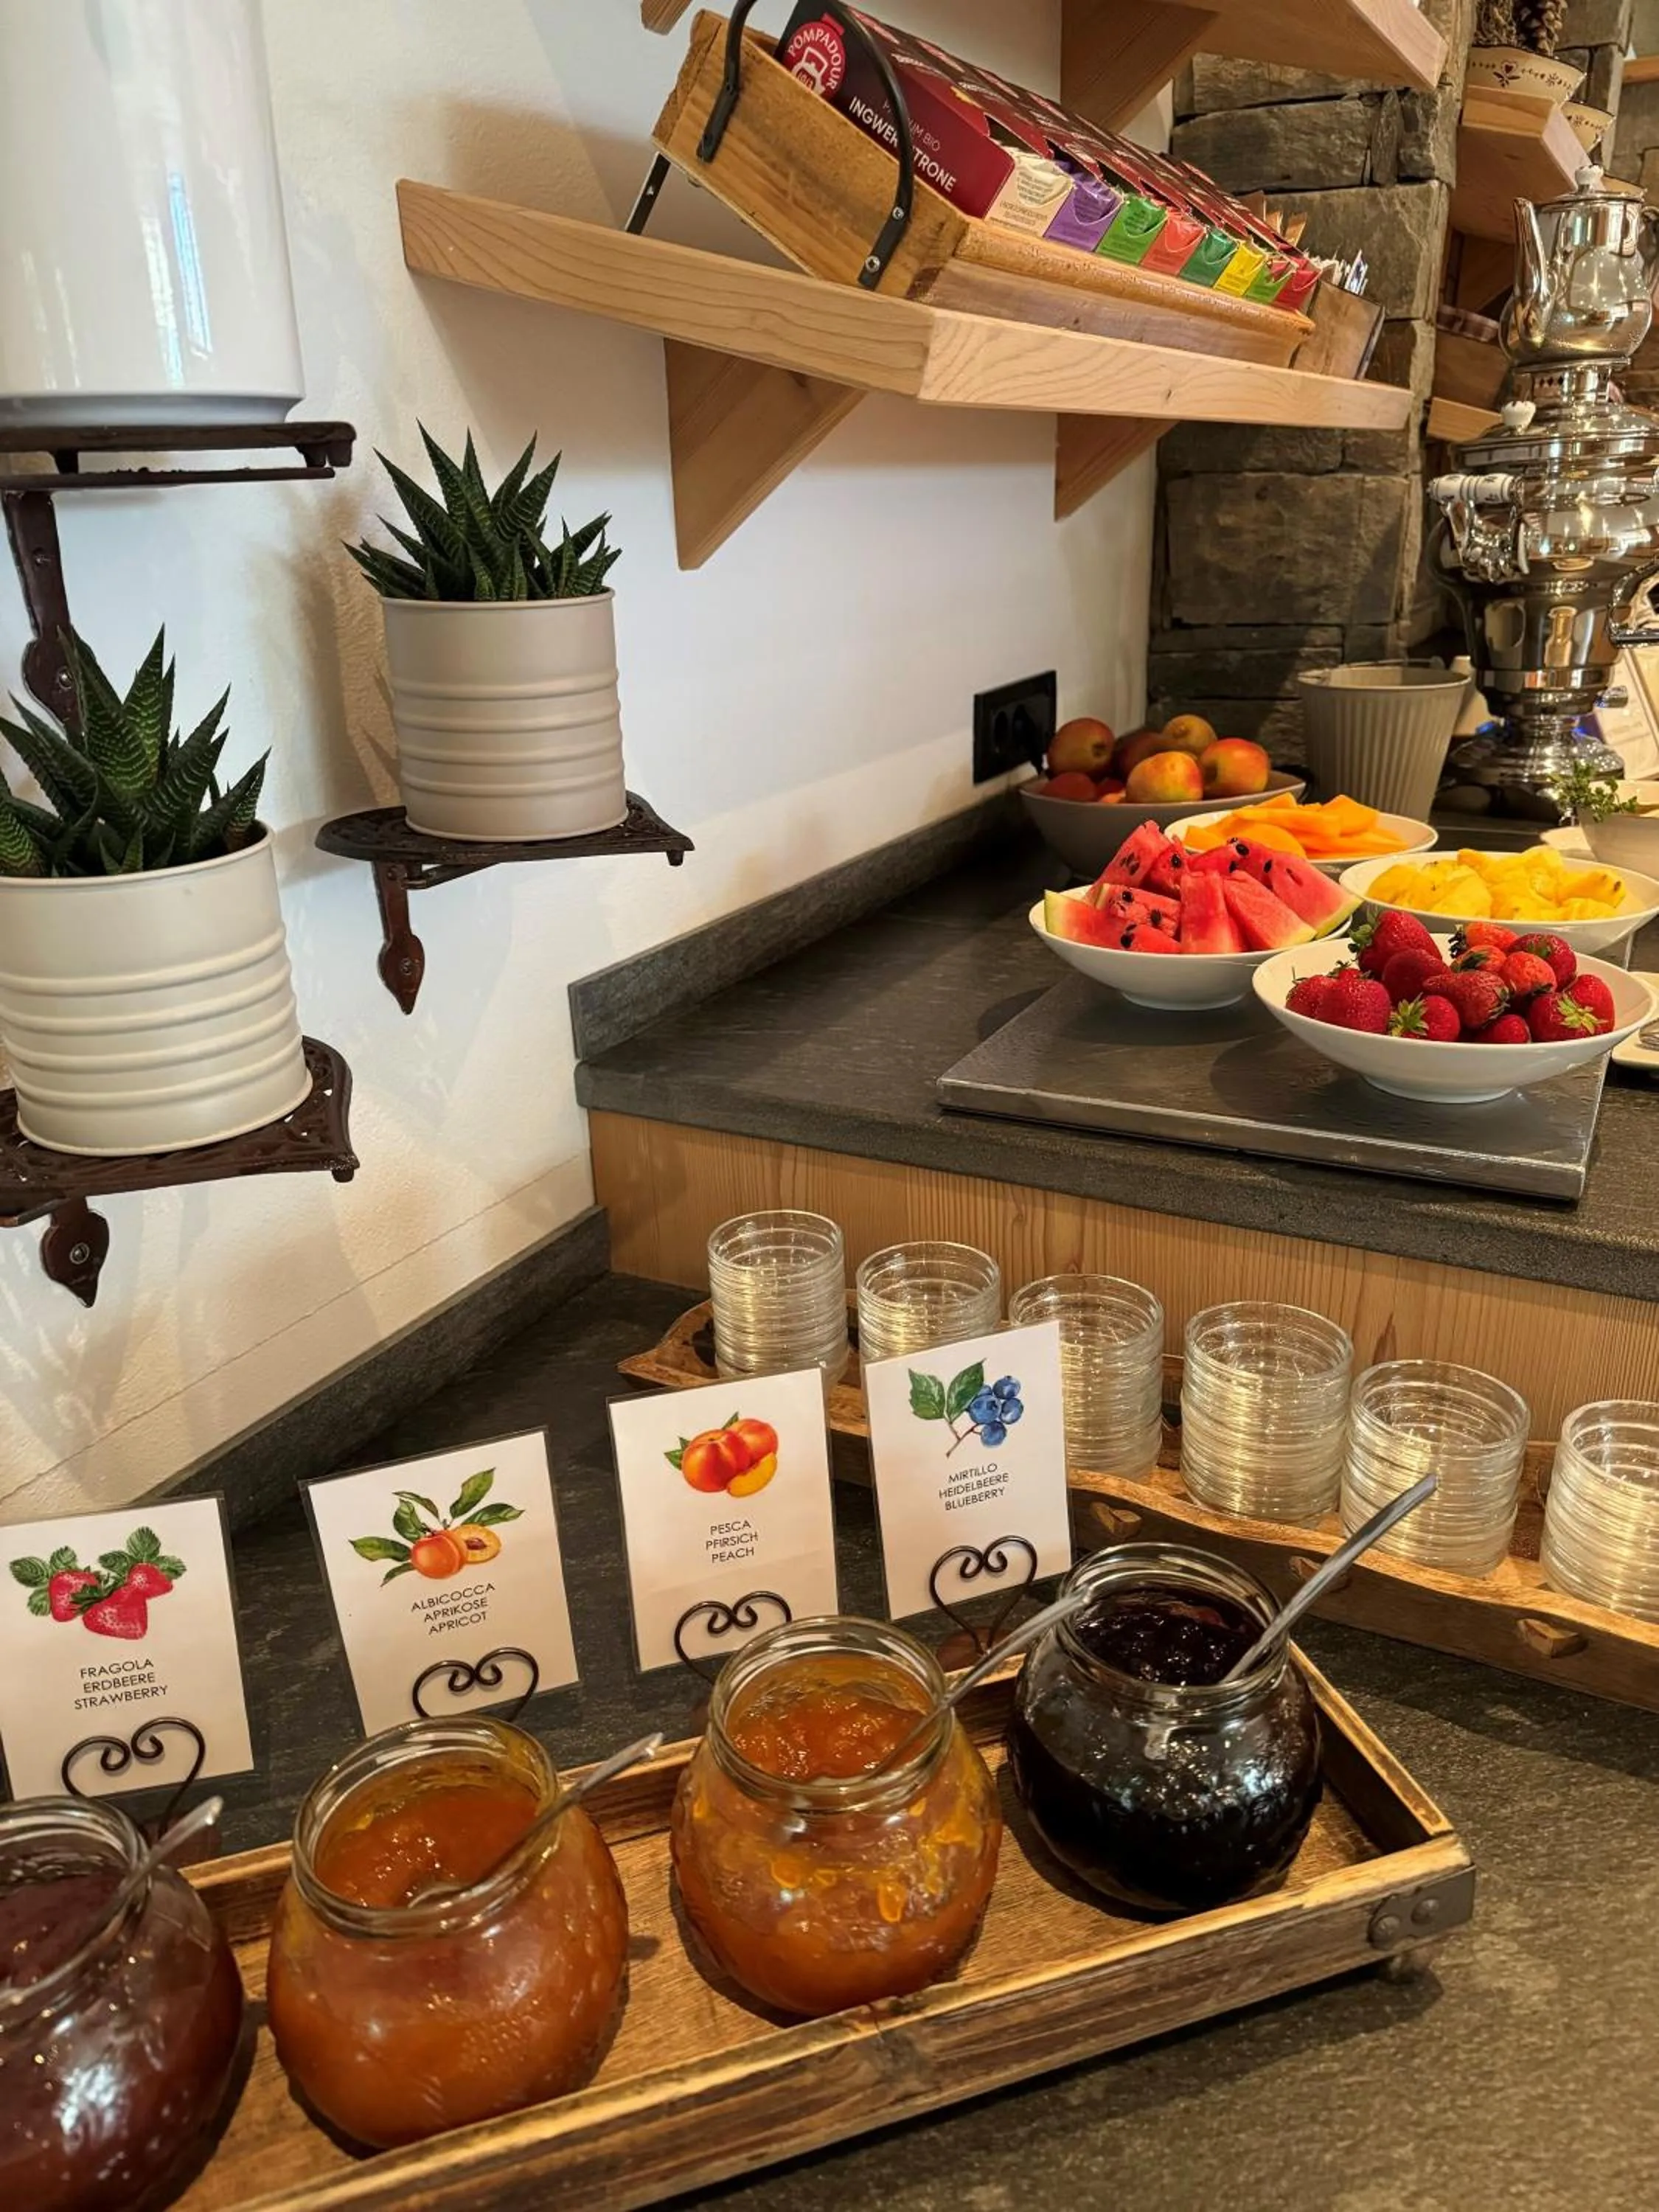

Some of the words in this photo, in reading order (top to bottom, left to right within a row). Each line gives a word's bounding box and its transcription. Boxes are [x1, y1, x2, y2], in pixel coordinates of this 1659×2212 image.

[787, 27, 841, 89] POMPADOUR
[913, 146, 956, 193] TRONE
[948, 1462, 998, 1484] MIRTILLO
[939, 1472, 1009, 1499] HEIDELBEERE
[945, 1486, 1005, 1511] BLUEBERRY
[710, 1520, 751, 1535] PESCA
[706, 1531, 758, 1551] PFIRSICH
[712, 1547, 754, 1563] PEACH
[411, 1583, 495, 1613] ALBICOCCA
[424, 1597, 488, 1623] APRIKOSE
[428, 1612, 487, 1635] APRICOT
[80, 1658, 154, 1679] FRAGOLA
[83, 1672, 156, 1694] ERDBEERE
[74, 1686, 168, 1710] STRAWBERRY
